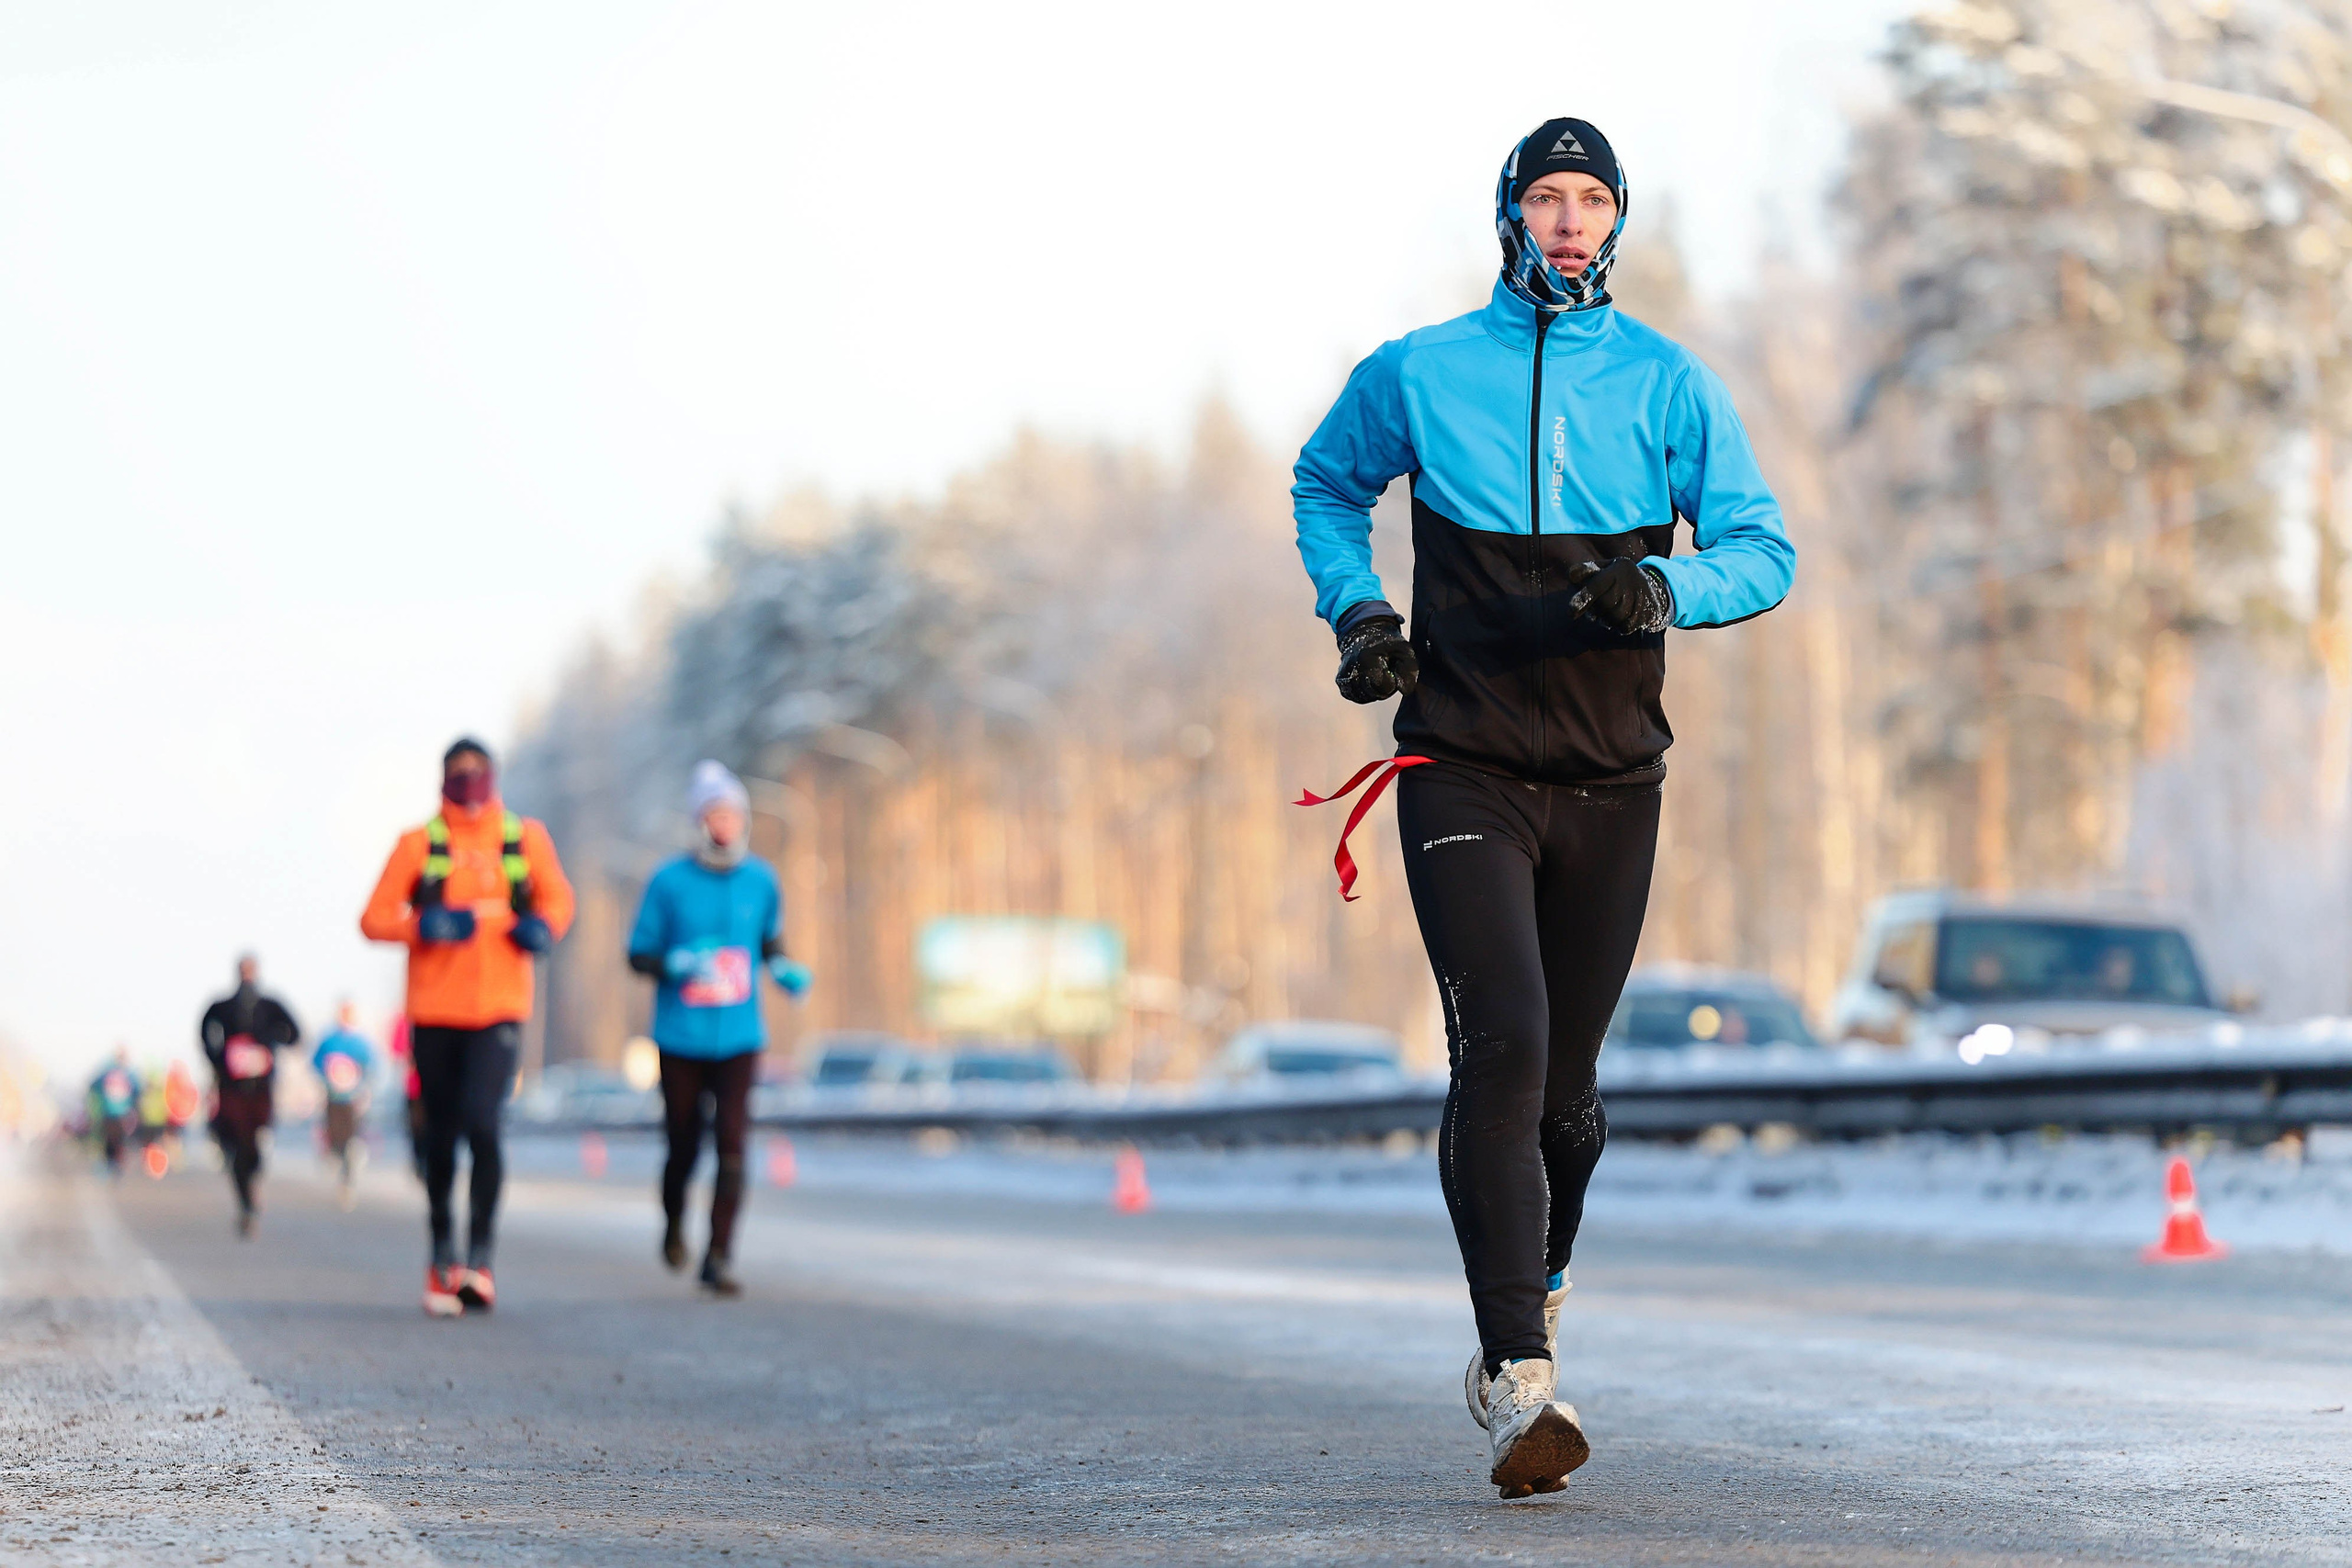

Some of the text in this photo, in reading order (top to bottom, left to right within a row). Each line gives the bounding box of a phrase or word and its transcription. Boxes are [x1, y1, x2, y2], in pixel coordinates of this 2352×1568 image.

[1546, 153, 1589, 162] FISCHER
[1552, 416, 1566, 507] NORDSKI
[1434, 834, 1483, 845] NORDSKI
